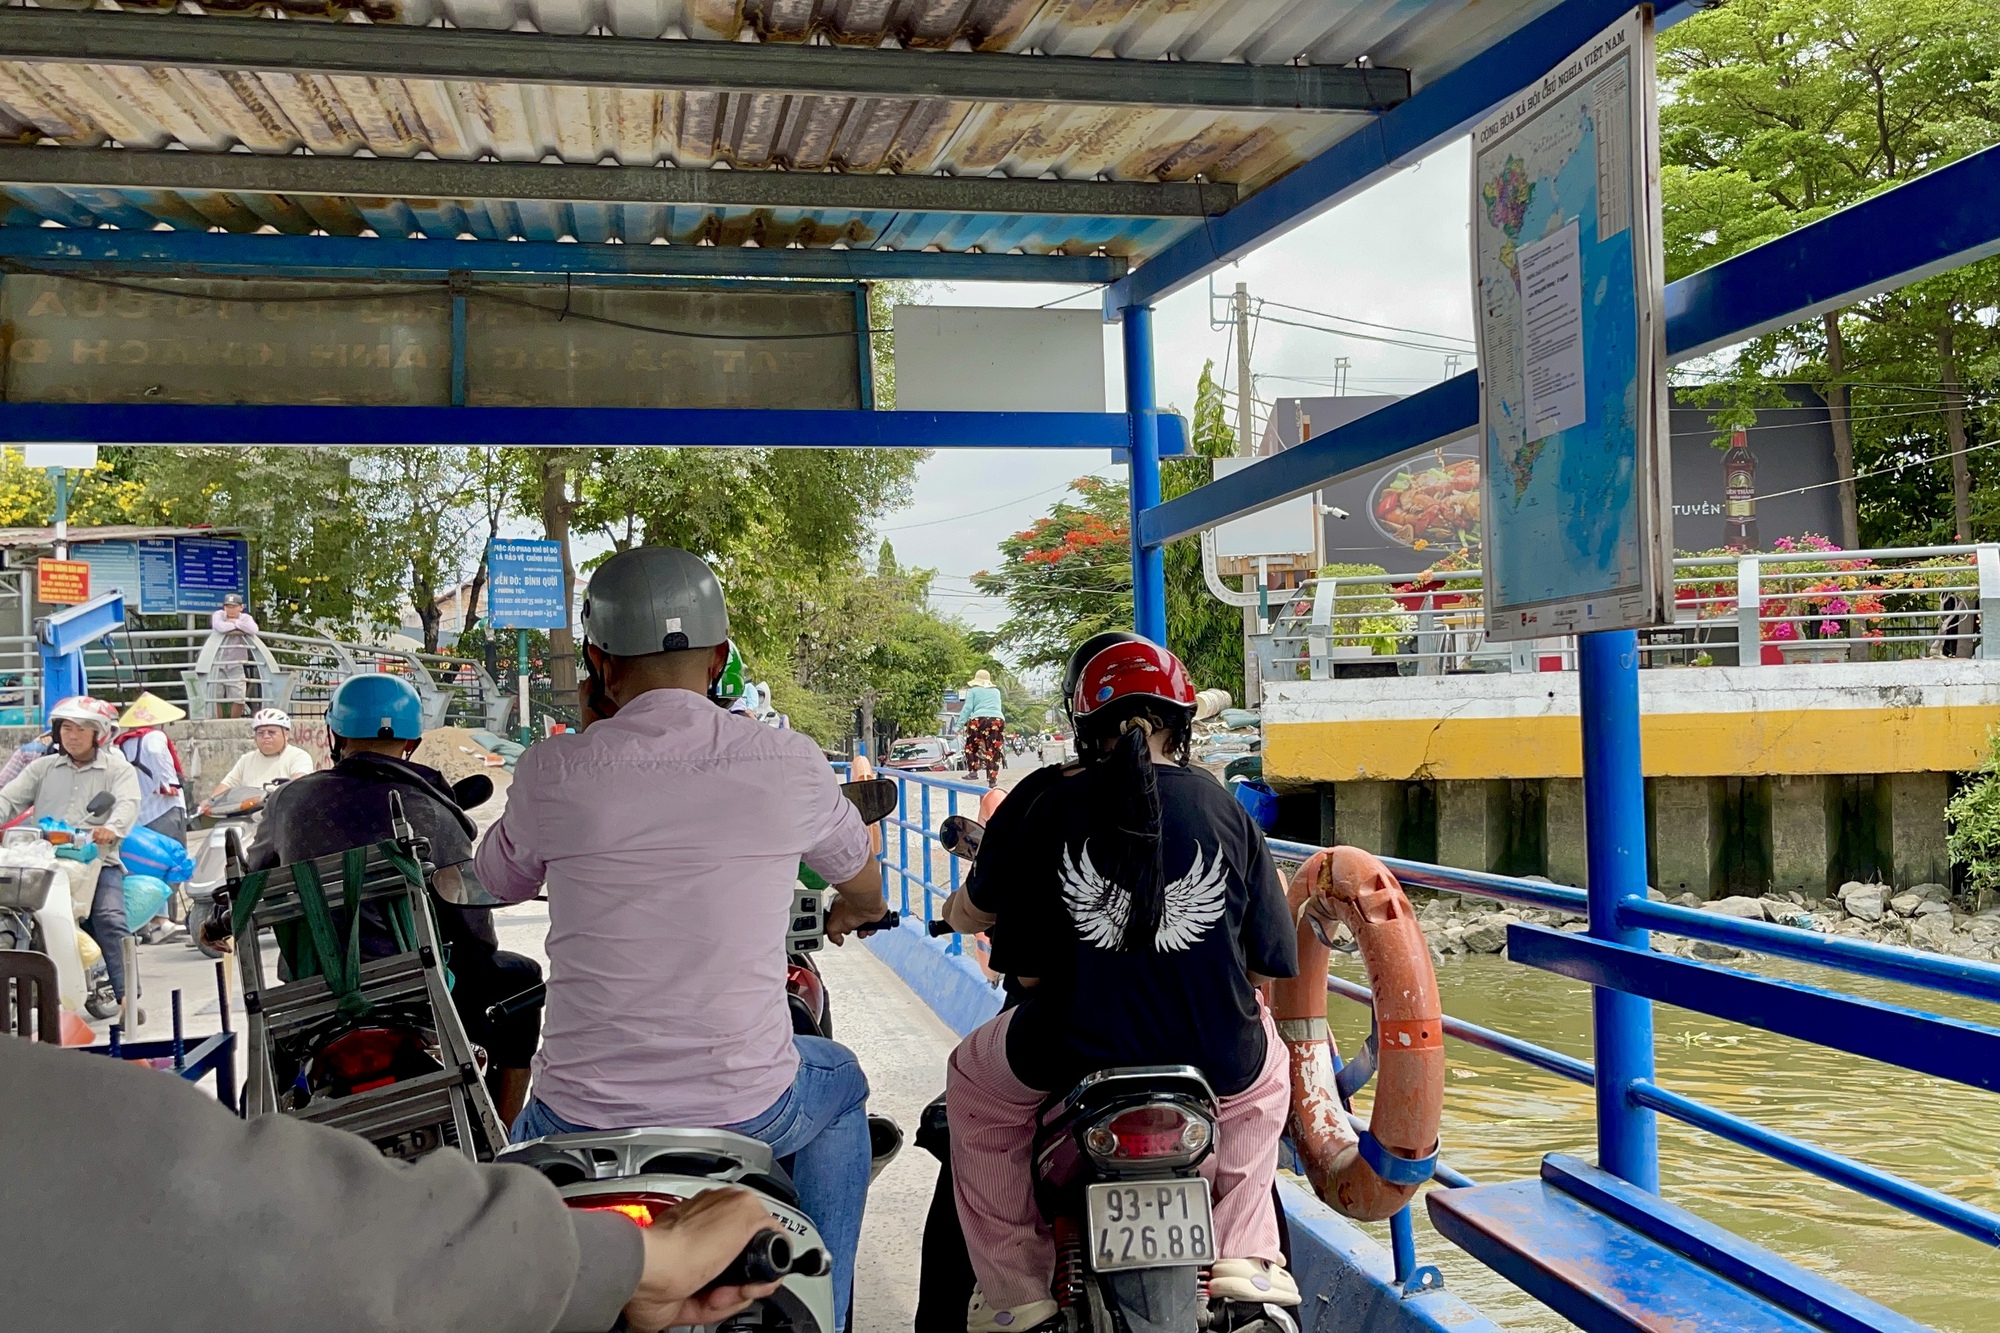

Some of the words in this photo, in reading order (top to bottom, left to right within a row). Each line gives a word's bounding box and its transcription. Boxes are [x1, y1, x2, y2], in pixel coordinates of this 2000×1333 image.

[1480, 122, 1499, 144] CỘNG
[1584, 45, 1603, 67] VIỆT
[1605, 29, 1625, 54] NAM
[1106, 1186, 1189, 1223] 93-P1
[1098, 1224, 1206, 1264] 426.88
